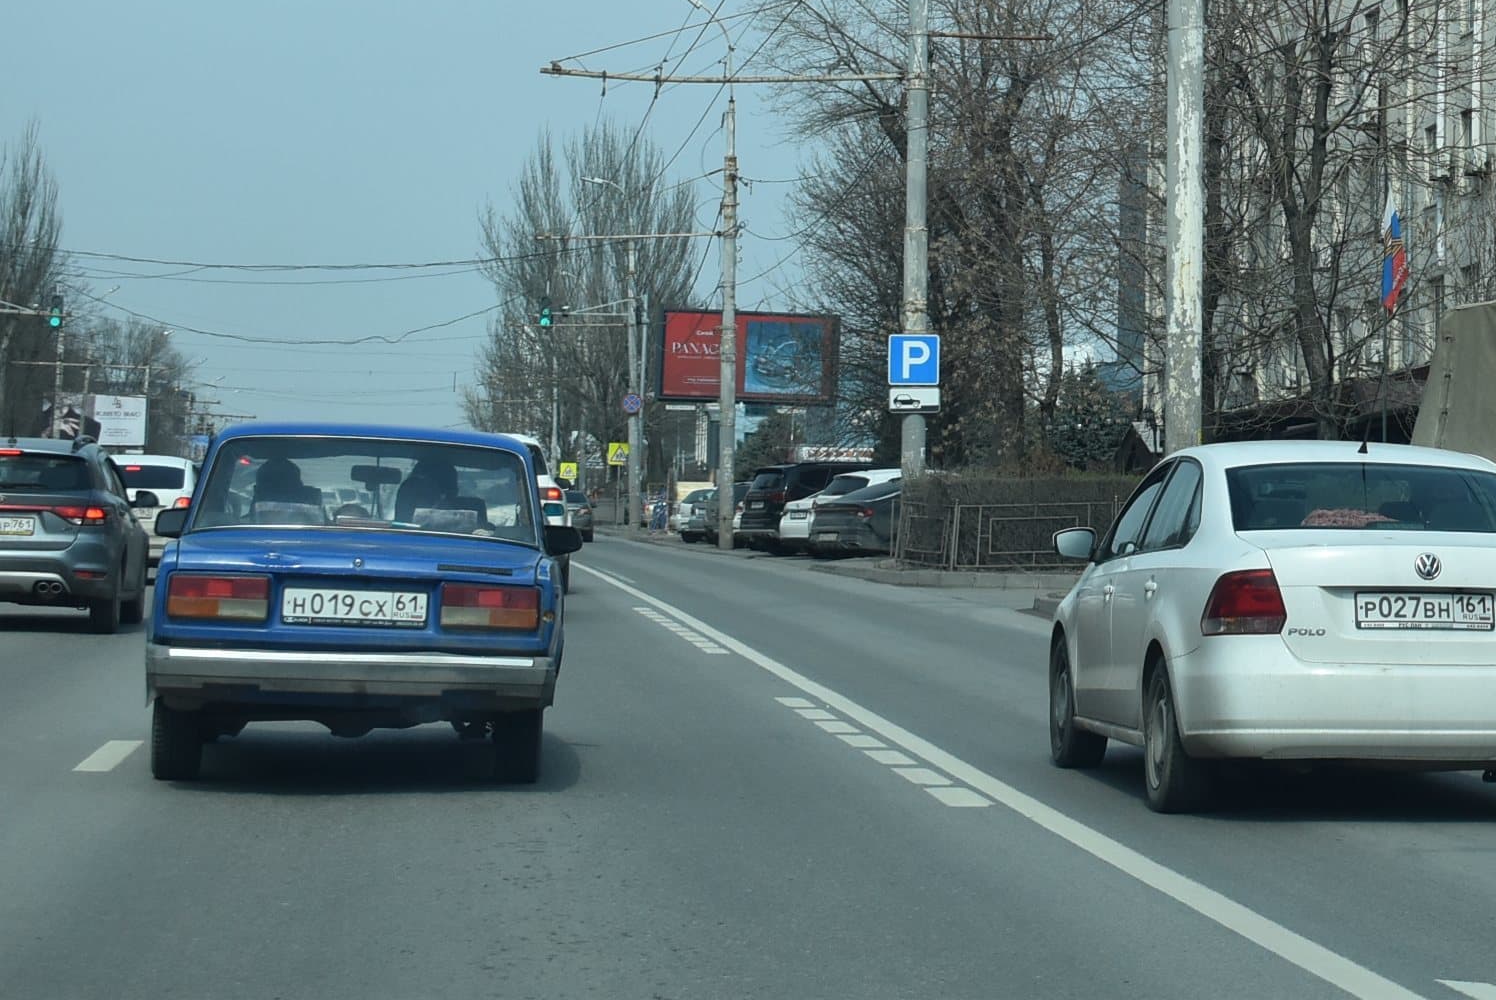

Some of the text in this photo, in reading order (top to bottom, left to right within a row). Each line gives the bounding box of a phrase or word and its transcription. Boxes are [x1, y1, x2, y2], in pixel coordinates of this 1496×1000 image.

[672, 341, 721, 355] PANAC
[903, 341, 930, 379] P
[293, 593, 418, 617] Н019СХ 61
[1364, 596, 1487, 619] Р027ВН 161
[1287, 628, 1326, 637] POLO
